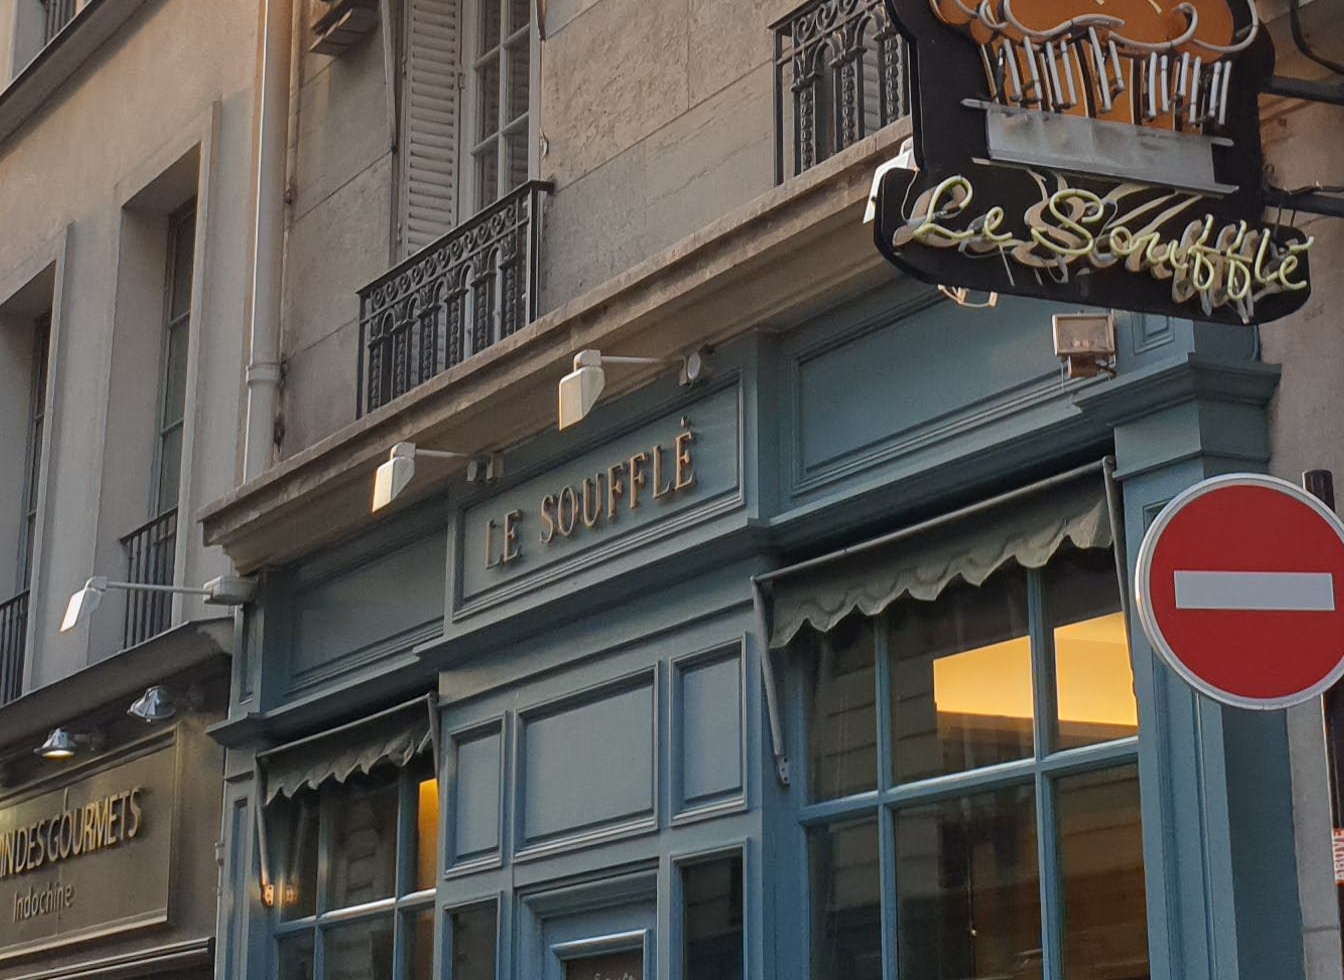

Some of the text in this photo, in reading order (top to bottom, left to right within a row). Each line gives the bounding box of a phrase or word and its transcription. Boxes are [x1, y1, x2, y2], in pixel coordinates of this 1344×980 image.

[896, 174, 1314, 308] Le Soufflé
[485, 413, 697, 570] LE SOUFFLÉ
[16, 820, 46, 873] DES
[47, 786, 143, 862] GOURMETS
[13, 880, 75, 922] Indochine
